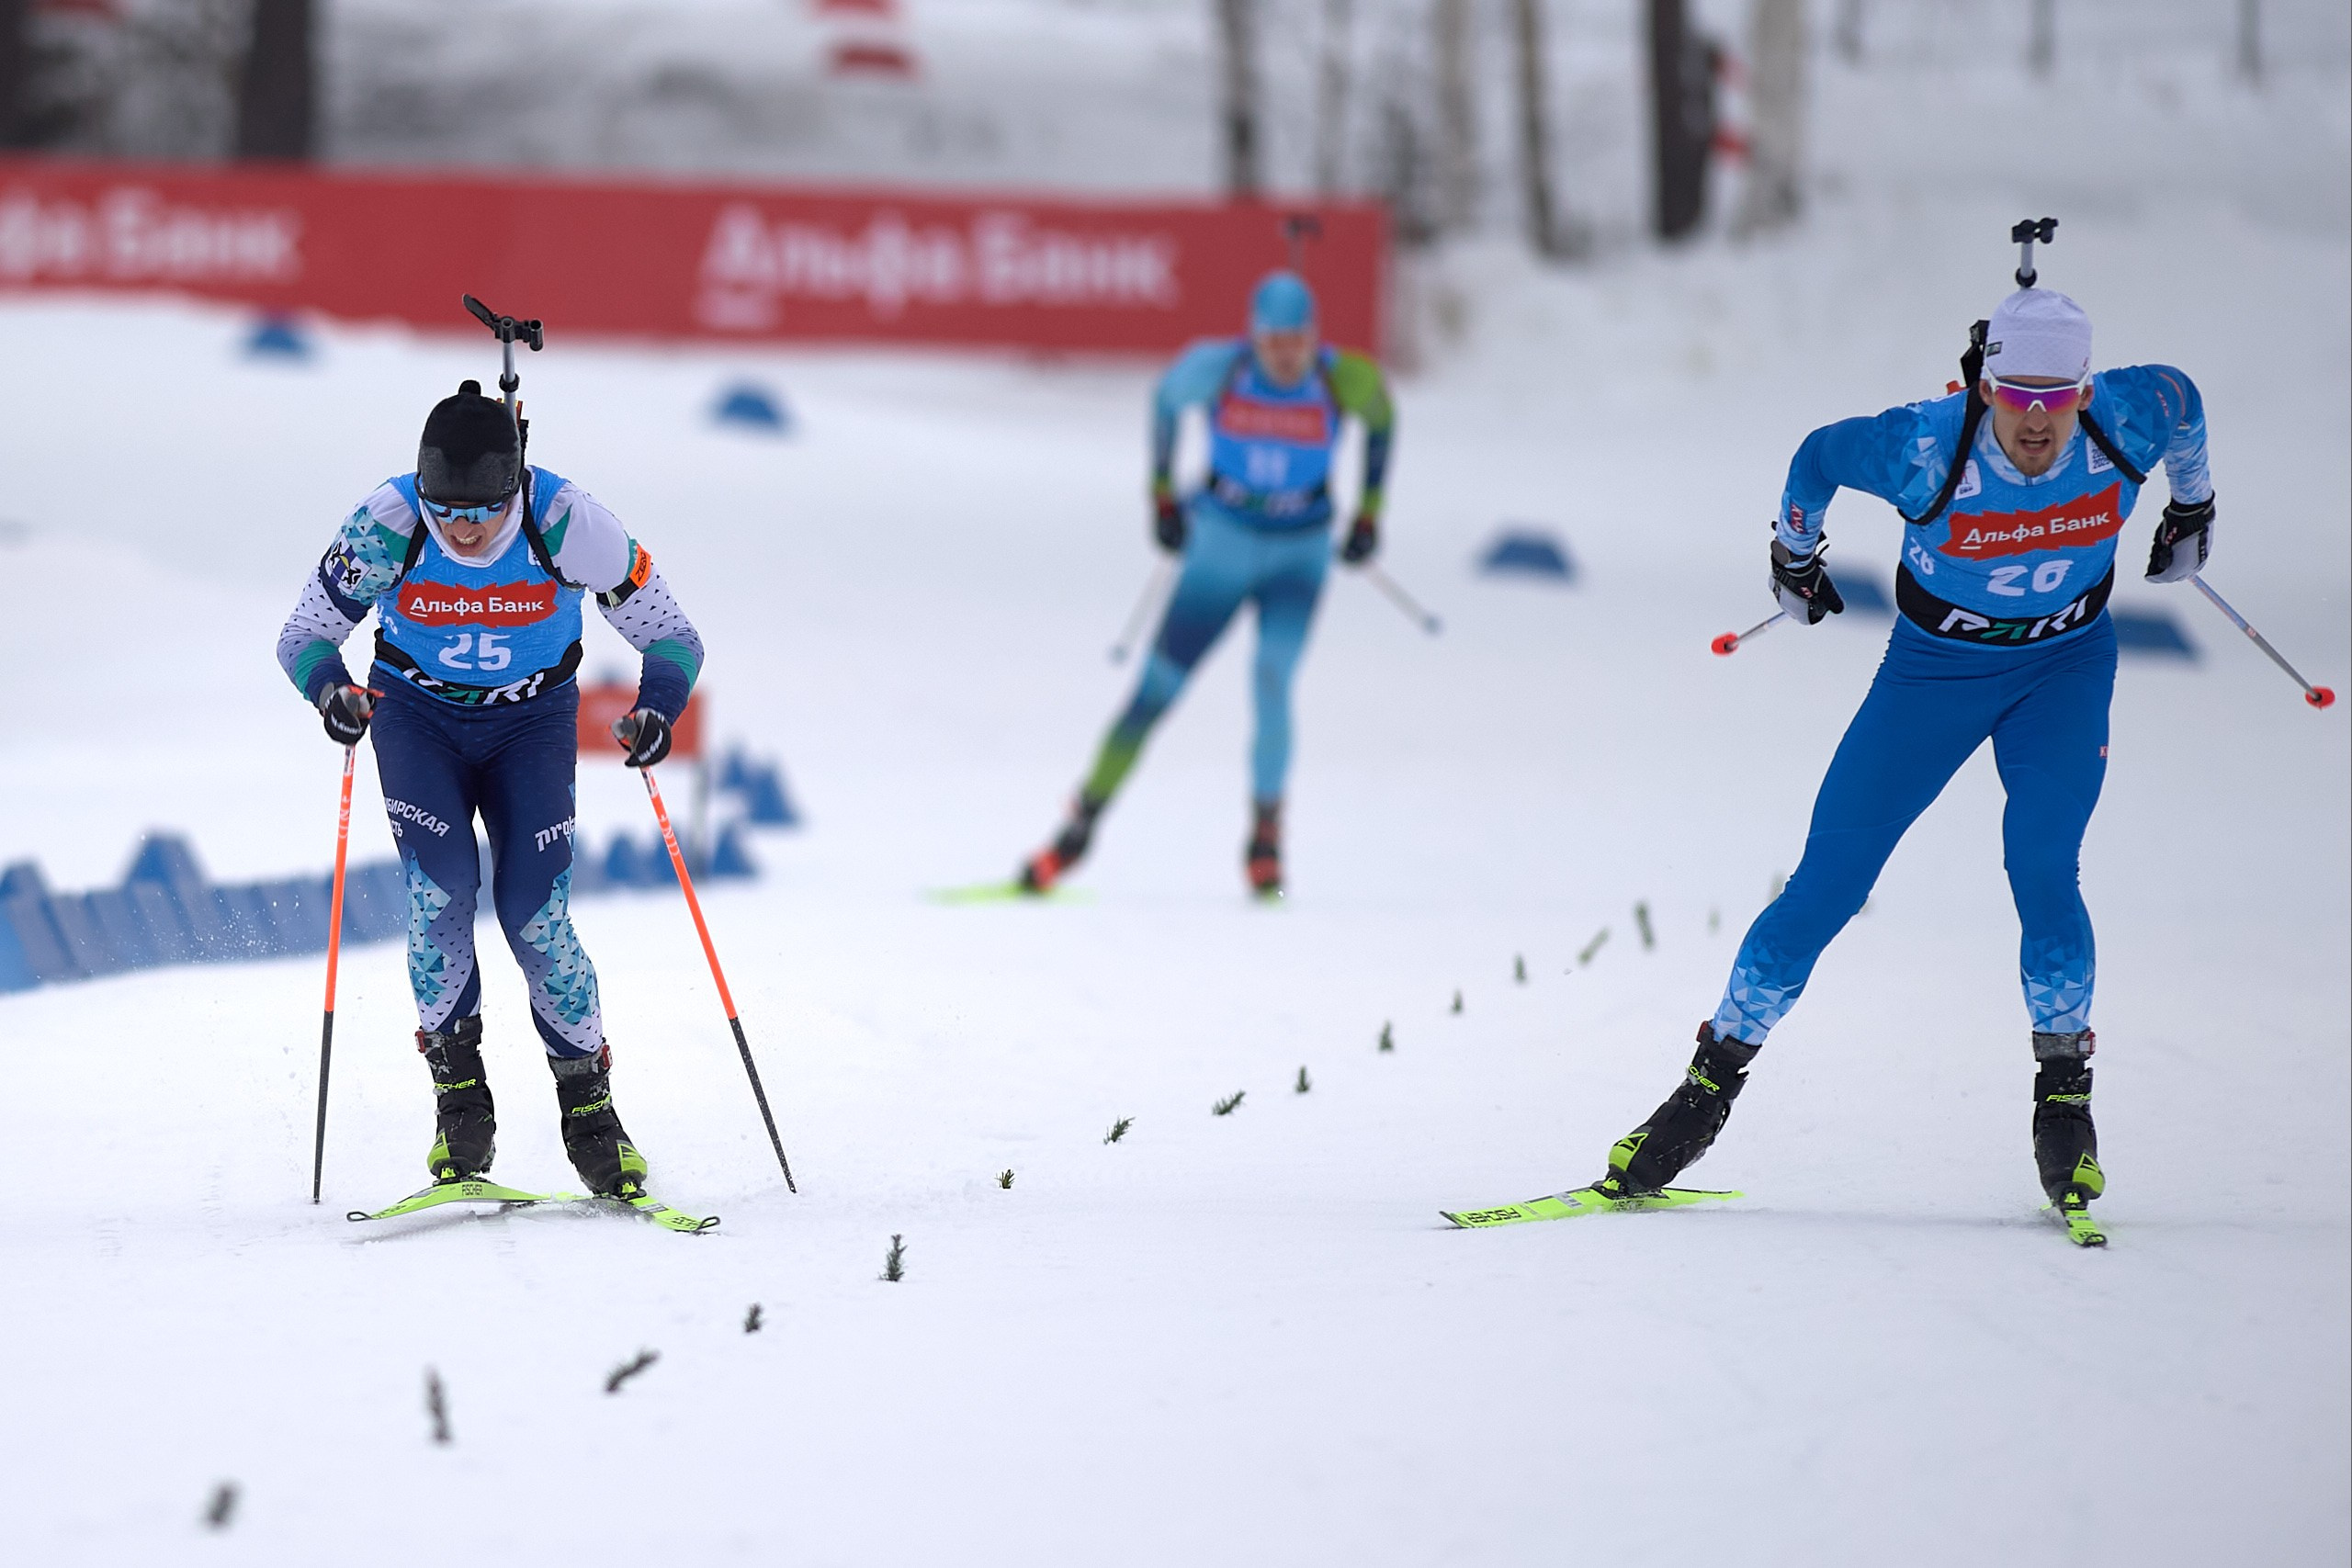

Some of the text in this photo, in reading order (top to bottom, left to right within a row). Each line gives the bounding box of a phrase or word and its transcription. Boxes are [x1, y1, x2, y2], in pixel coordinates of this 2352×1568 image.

[1960, 512, 2110, 550] Альфа Банк
[1986, 559, 2075, 596] 26
[410, 597, 545, 617] Альфа Банк
[1938, 594, 2090, 639] PARI
[438, 633, 512, 671] 25
[384, 797, 450, 838] БИРСКАЯ
[1469, 1207, 1521, 1224] FISCHER
